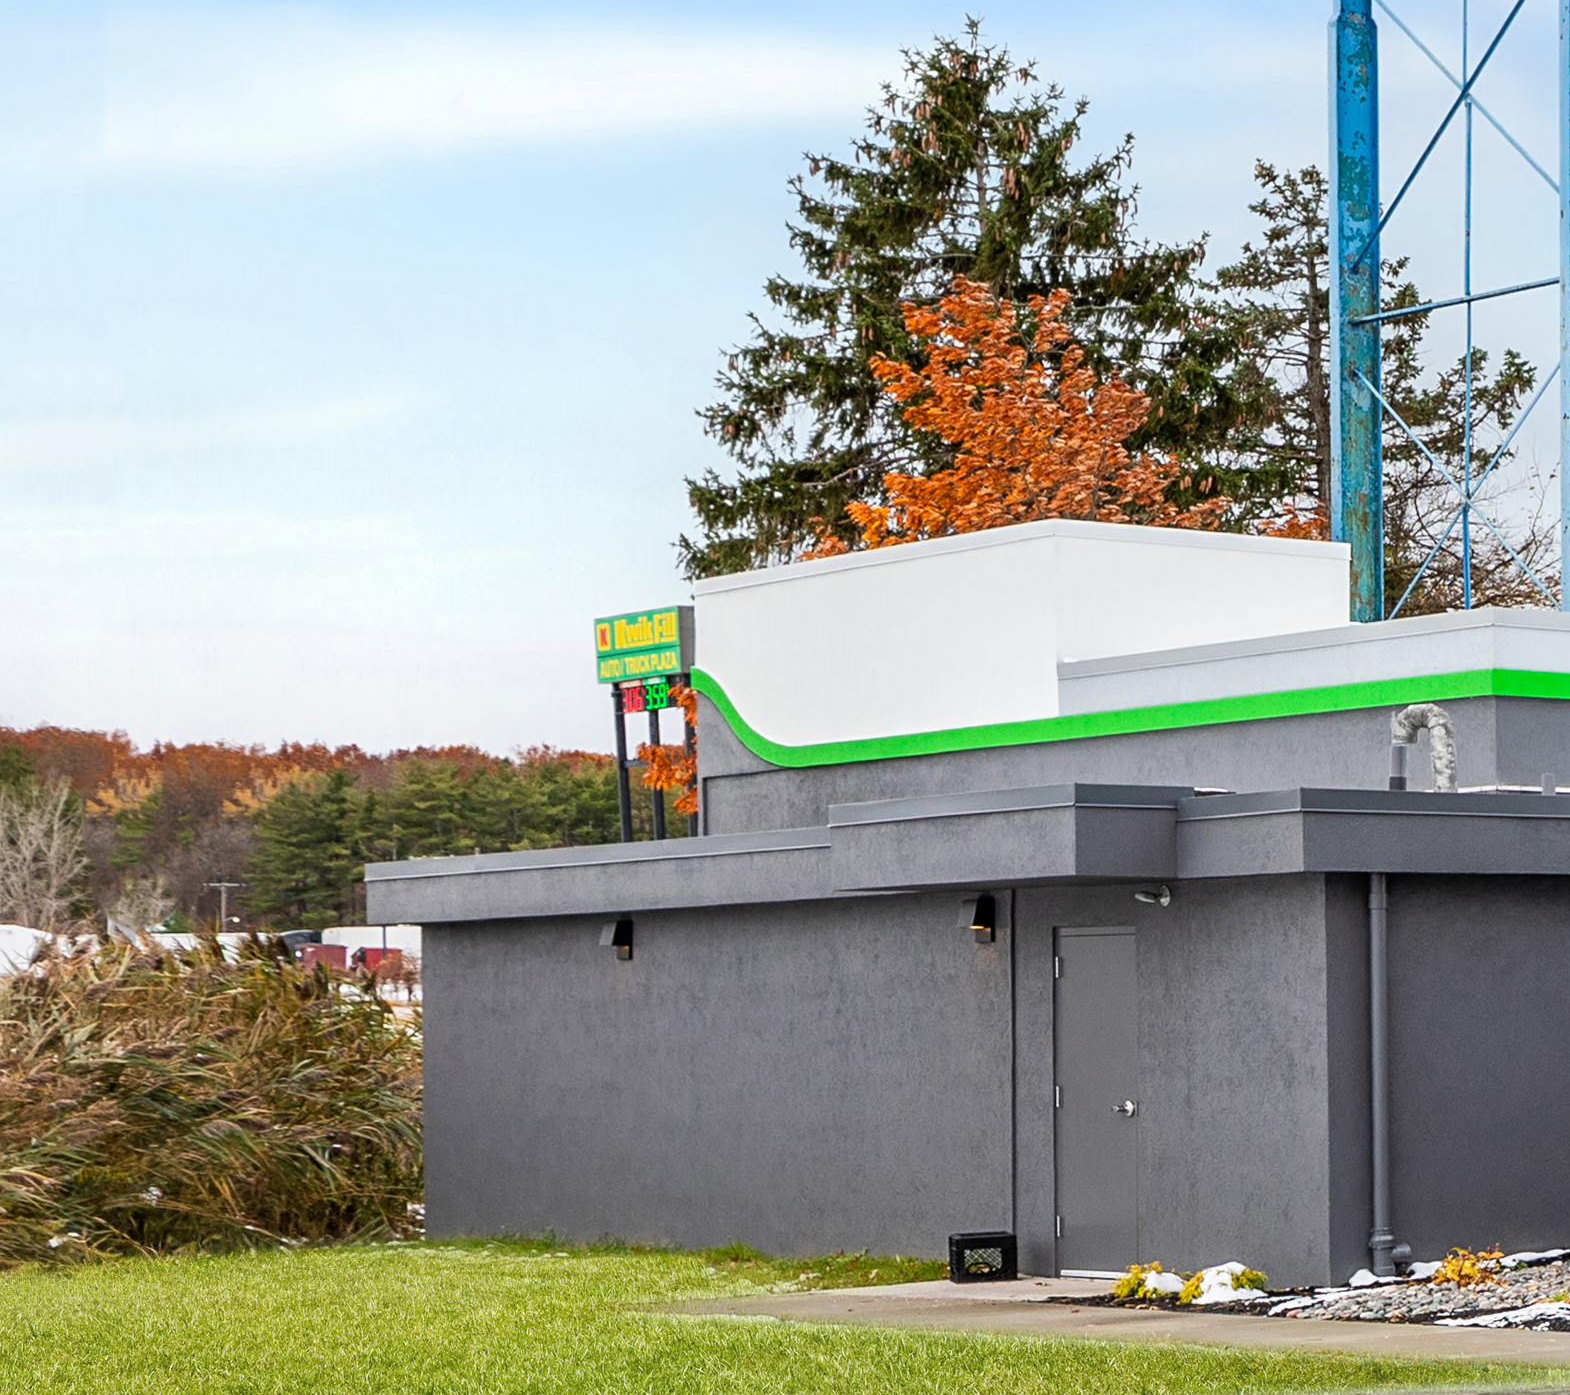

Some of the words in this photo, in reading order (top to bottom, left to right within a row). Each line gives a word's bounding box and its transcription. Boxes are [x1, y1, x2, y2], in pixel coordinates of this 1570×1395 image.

[614, 616, 653, 650] Kwik
[653, 612, 677, 644] Fill
[624, 654, 650, 675] TRUCK
[650, 651, 677, 671] PLAZA
